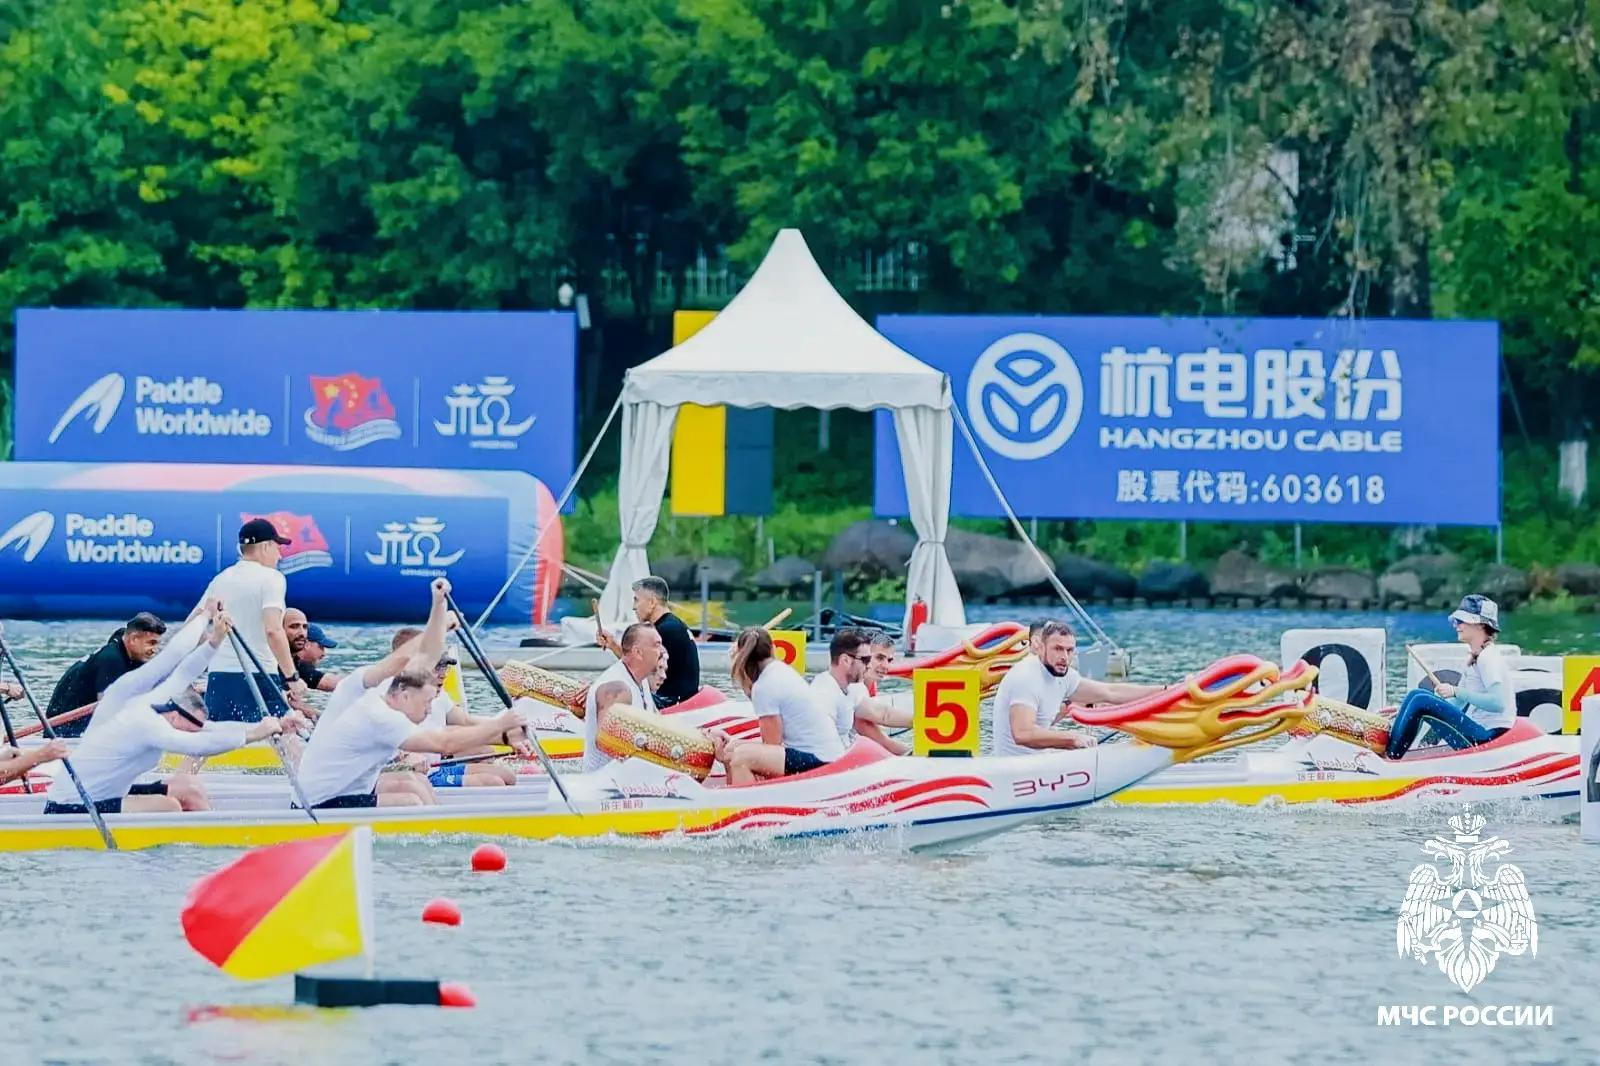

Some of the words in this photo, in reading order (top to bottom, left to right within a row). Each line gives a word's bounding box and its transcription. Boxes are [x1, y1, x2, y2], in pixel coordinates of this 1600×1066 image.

[136, 376, 222, 405] Paddle
[1100, 347, 1402, 421] 杭电股份
[136, 408, 271, 436] Worldwide
[1101, 428, 1287, 451] HANGZHOU
[1295, 430, 1402, 452] CABLE
[1117, 469, 1385, 504] 股票代码:603618
[66, 513, 154, 538] Paddle
[66, 539, 203, 565] Worldwide
[923, 680, 969, 745] 5
[1012, 771, 1090, 798] BYD
